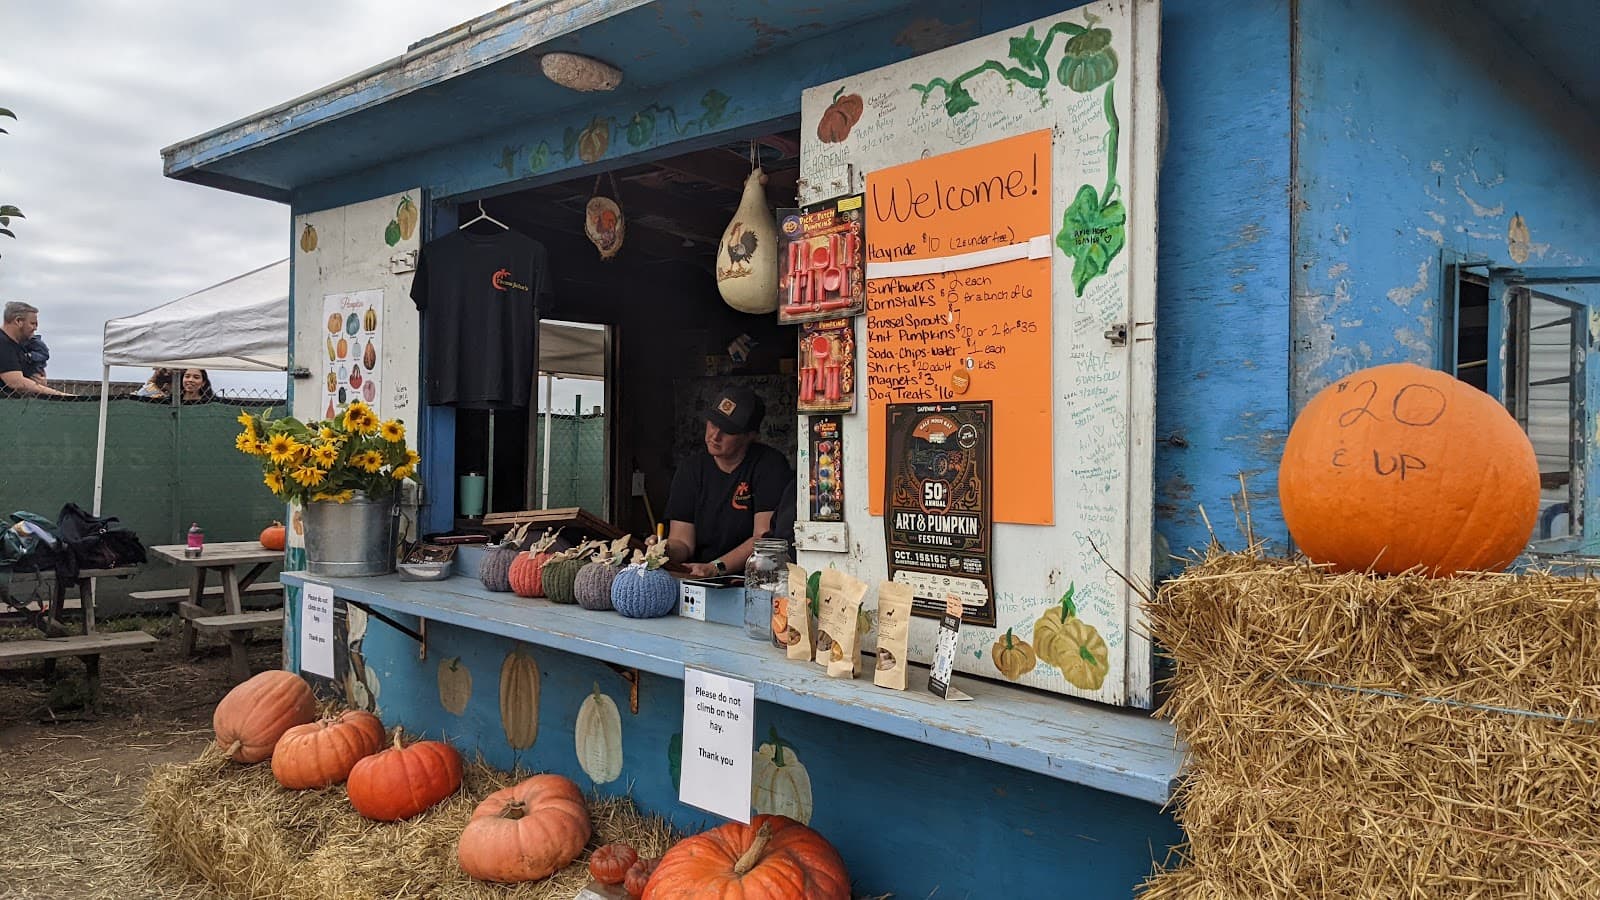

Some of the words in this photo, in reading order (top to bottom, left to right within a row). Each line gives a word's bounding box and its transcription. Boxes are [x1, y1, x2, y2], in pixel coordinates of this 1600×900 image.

[873, 153, 1038, 223] Welcome!
[868, 243, 916, 262] Hayride
[922, 232, 941, 253] $10
[867, 278, 936, 295] Sunflowers
[965, 276, 991, 286] each
[964, 291, 976, 303] for
[983, 290, 1008, 301] bunch
[1010, 285, 1020, 298] of
[1021, 286, 1033, 299] 6
[905, 313, 948, 329] Sprouts
[868, 331, 893, 342] Knit
[898, 329, 956, 344] Pumpkins
[955, 324, 973, 338] $20
[978, 328, 987, 337] or
[992, 324, 1000, 337] 2
[1002, 325, 1016, 336] for
[1016, 320, 1037, 333] $35
[984, 344, 1006, 354] each
[867, 361, 911, 373] Shirts
[912, 359, 929, 371] $20
[929, 361, 951, 372] adult
[978, 359, 996, 370] kids
[919, 372, 935, 386] $3
[868, 388, 892, 404] Dog
[892, 386, 932, 399] Treats
[934, 384, 954, 399] $16
[1338, 379, 1447, 428] $20
[1373, 449, 1426, 480] UP
[925, 499, 946, 507] ANNUAL
[895, 513, 916, 531] ART
[916, 513, 926, 532] &
[928, 515, 978, 535] PUMPKIN
[918, 534, 953, 546] FESTIVAL
[894, 550, 913, 560] OCT.
[915, 552, 939, 563] 15&16
[695, 686, 717, 701] Please
[718, 692, 727, 701] do
[728, 697, 741, 707] not
[696, 703, 715, 715] climb
[716, 709, 725, 717] on
[727, 710, 739, 721] the
[710, 720, 724, 734] hay.
[698, 747, 719, 762] Thank
[720, 756, 734, 767] you
